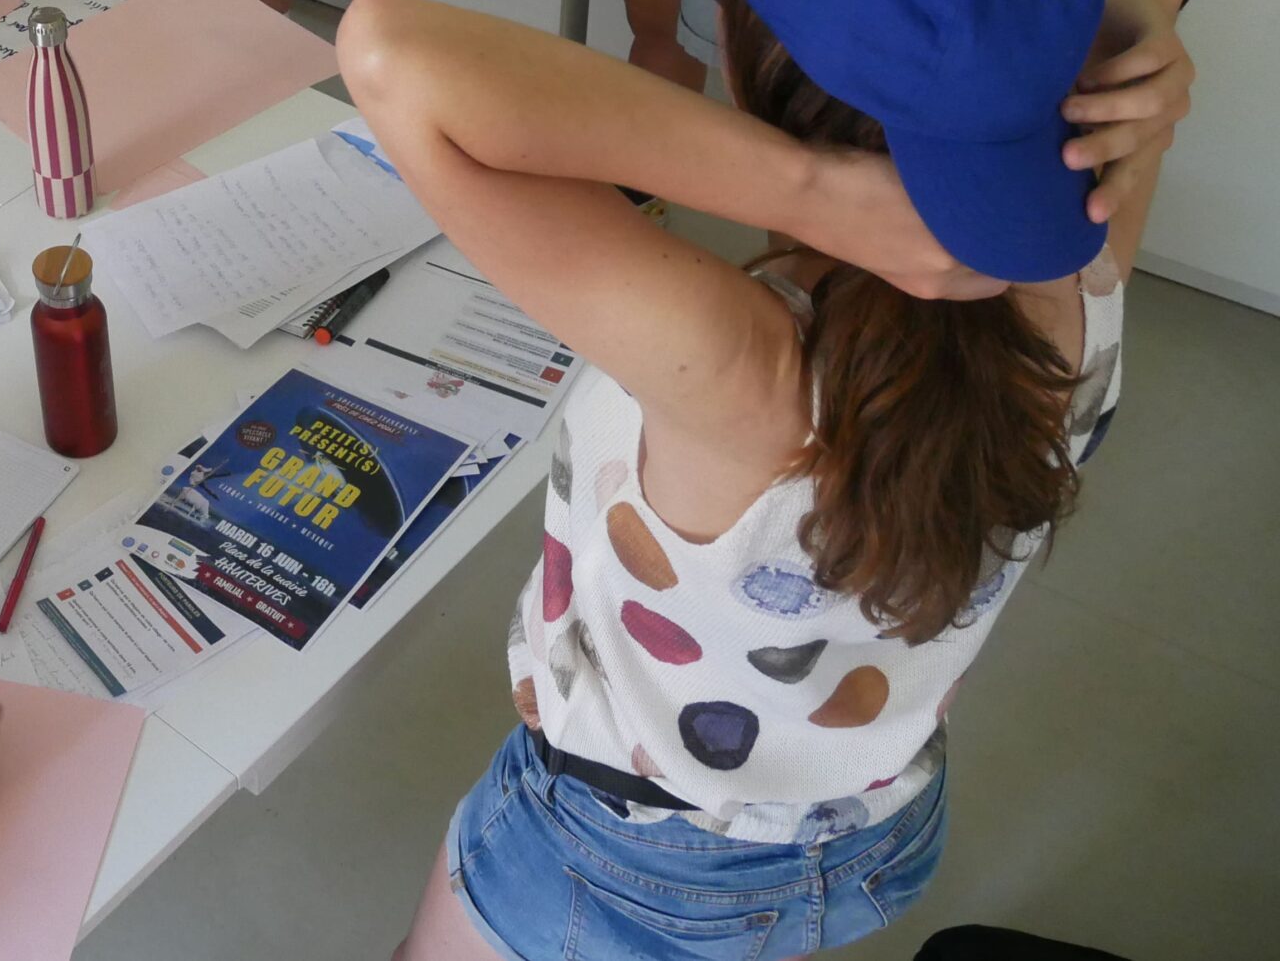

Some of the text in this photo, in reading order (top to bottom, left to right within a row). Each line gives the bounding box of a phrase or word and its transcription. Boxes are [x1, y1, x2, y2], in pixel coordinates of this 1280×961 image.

[288, 425, 380, 475] PRÉSENT(S)
[311, 421, 379, 457] PETIT(S)
[242, 468, 339, 530] FUTUR
[260, 447, 361, 508] GRAND
[214, 557, 291, 606] HAUTERIVES
[215, 519, 258, 548] MARDI
[256, 542, 275, 558] 16
[272, 552, 303, 576] JUIN
[311, 575, 337, 597] 18h
[219, 541, 308, 597] Place de la mairie
[213, 576, 245, 599] FAMILIAL
[255, 600, 286, 623] GRATUIT
